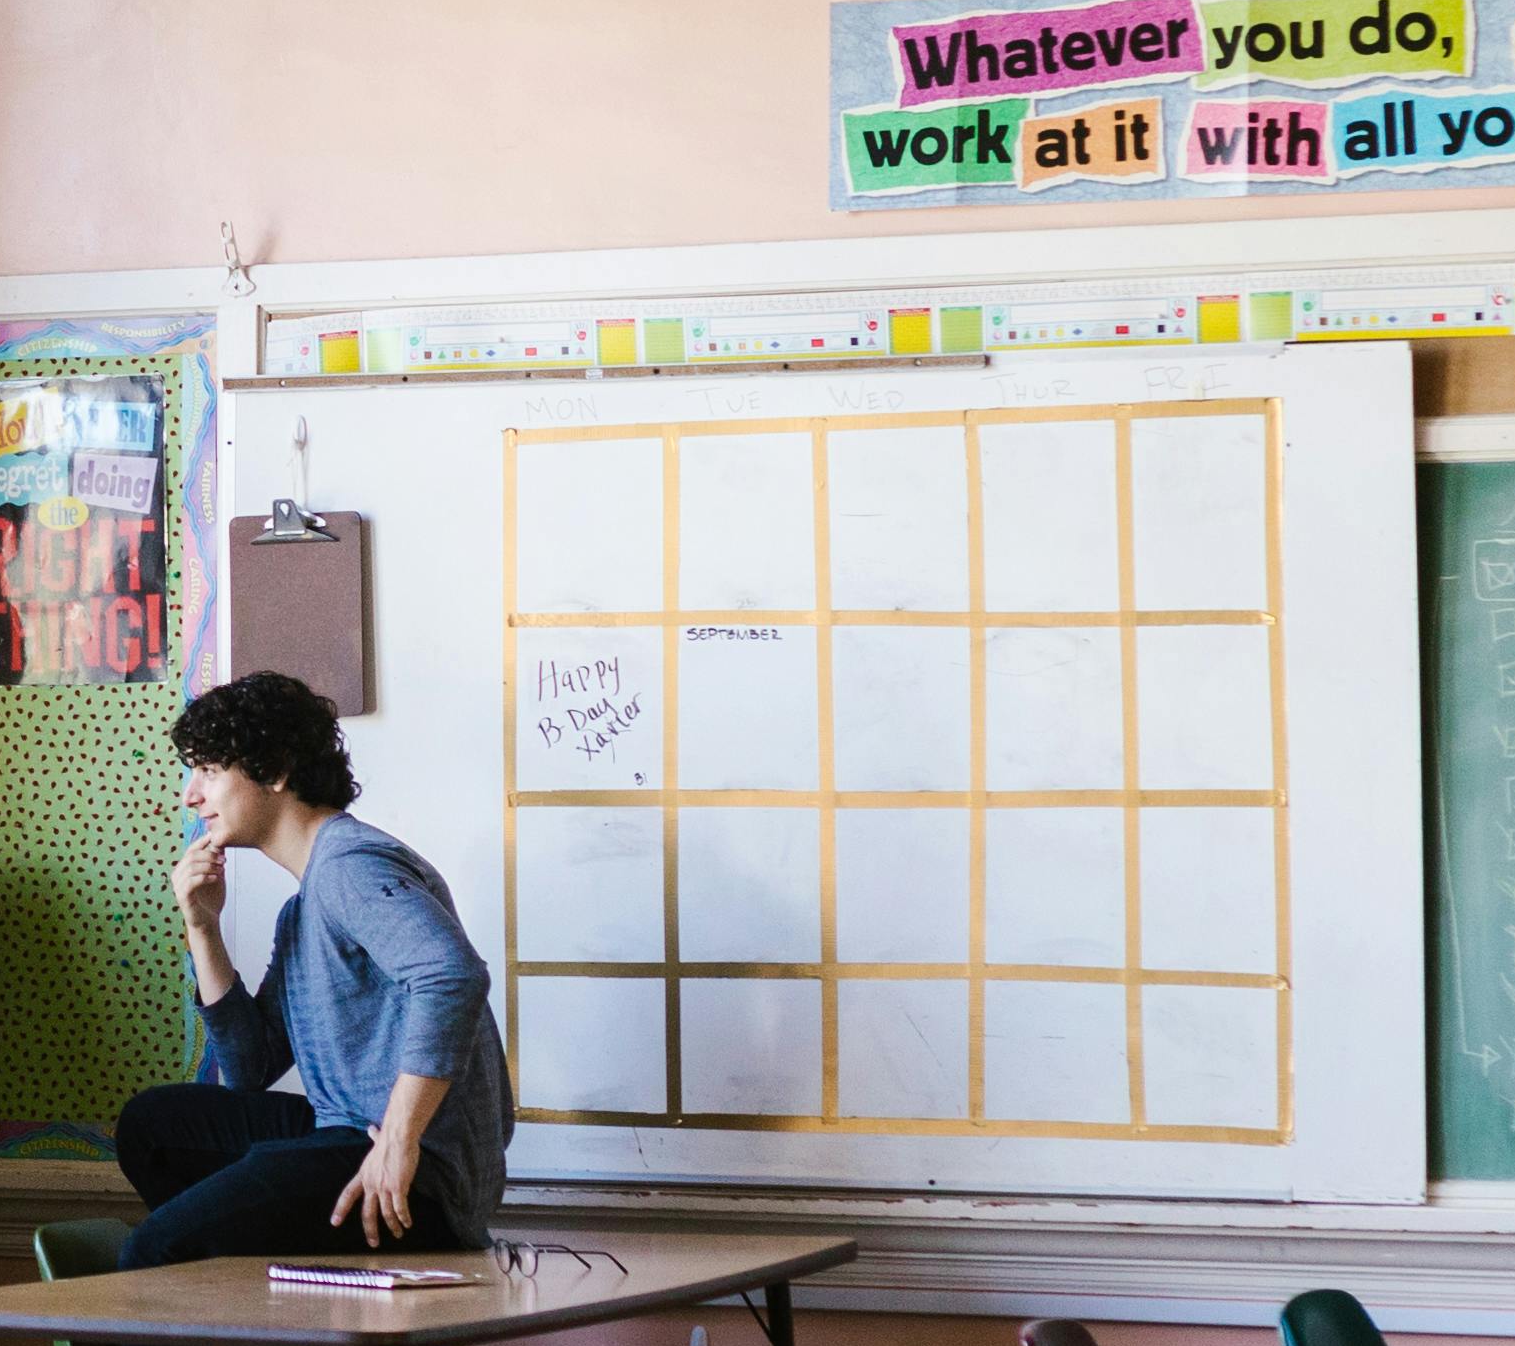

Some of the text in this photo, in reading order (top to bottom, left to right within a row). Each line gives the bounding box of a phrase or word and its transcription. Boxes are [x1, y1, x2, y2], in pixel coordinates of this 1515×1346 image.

[904, 0, 1454, 91] Whatever you do,
[862, 110, 1011, 167] work
[1036, 119, 1091, 167] at
[1114, 110, 1151, 162] it
[1198, 111, 1321, 166] with
[1344, 100, 1415, 160] all
[17, 338, 97, 358] CITIZENSHIP
[100, 319, 187, 338] RESPONSIBILITY
[526, 364, 1229, 424] MON TUE WED THUR FRI
[77, 460, 151, 508] doing
[201, 460, 215, 524] FAIRNESS
[49, 501, 78, 526] the
[189, 558, 201, 615] CARING
[202, 653, 214, 694] RESP
[537, 656, 620, 701] Happy
